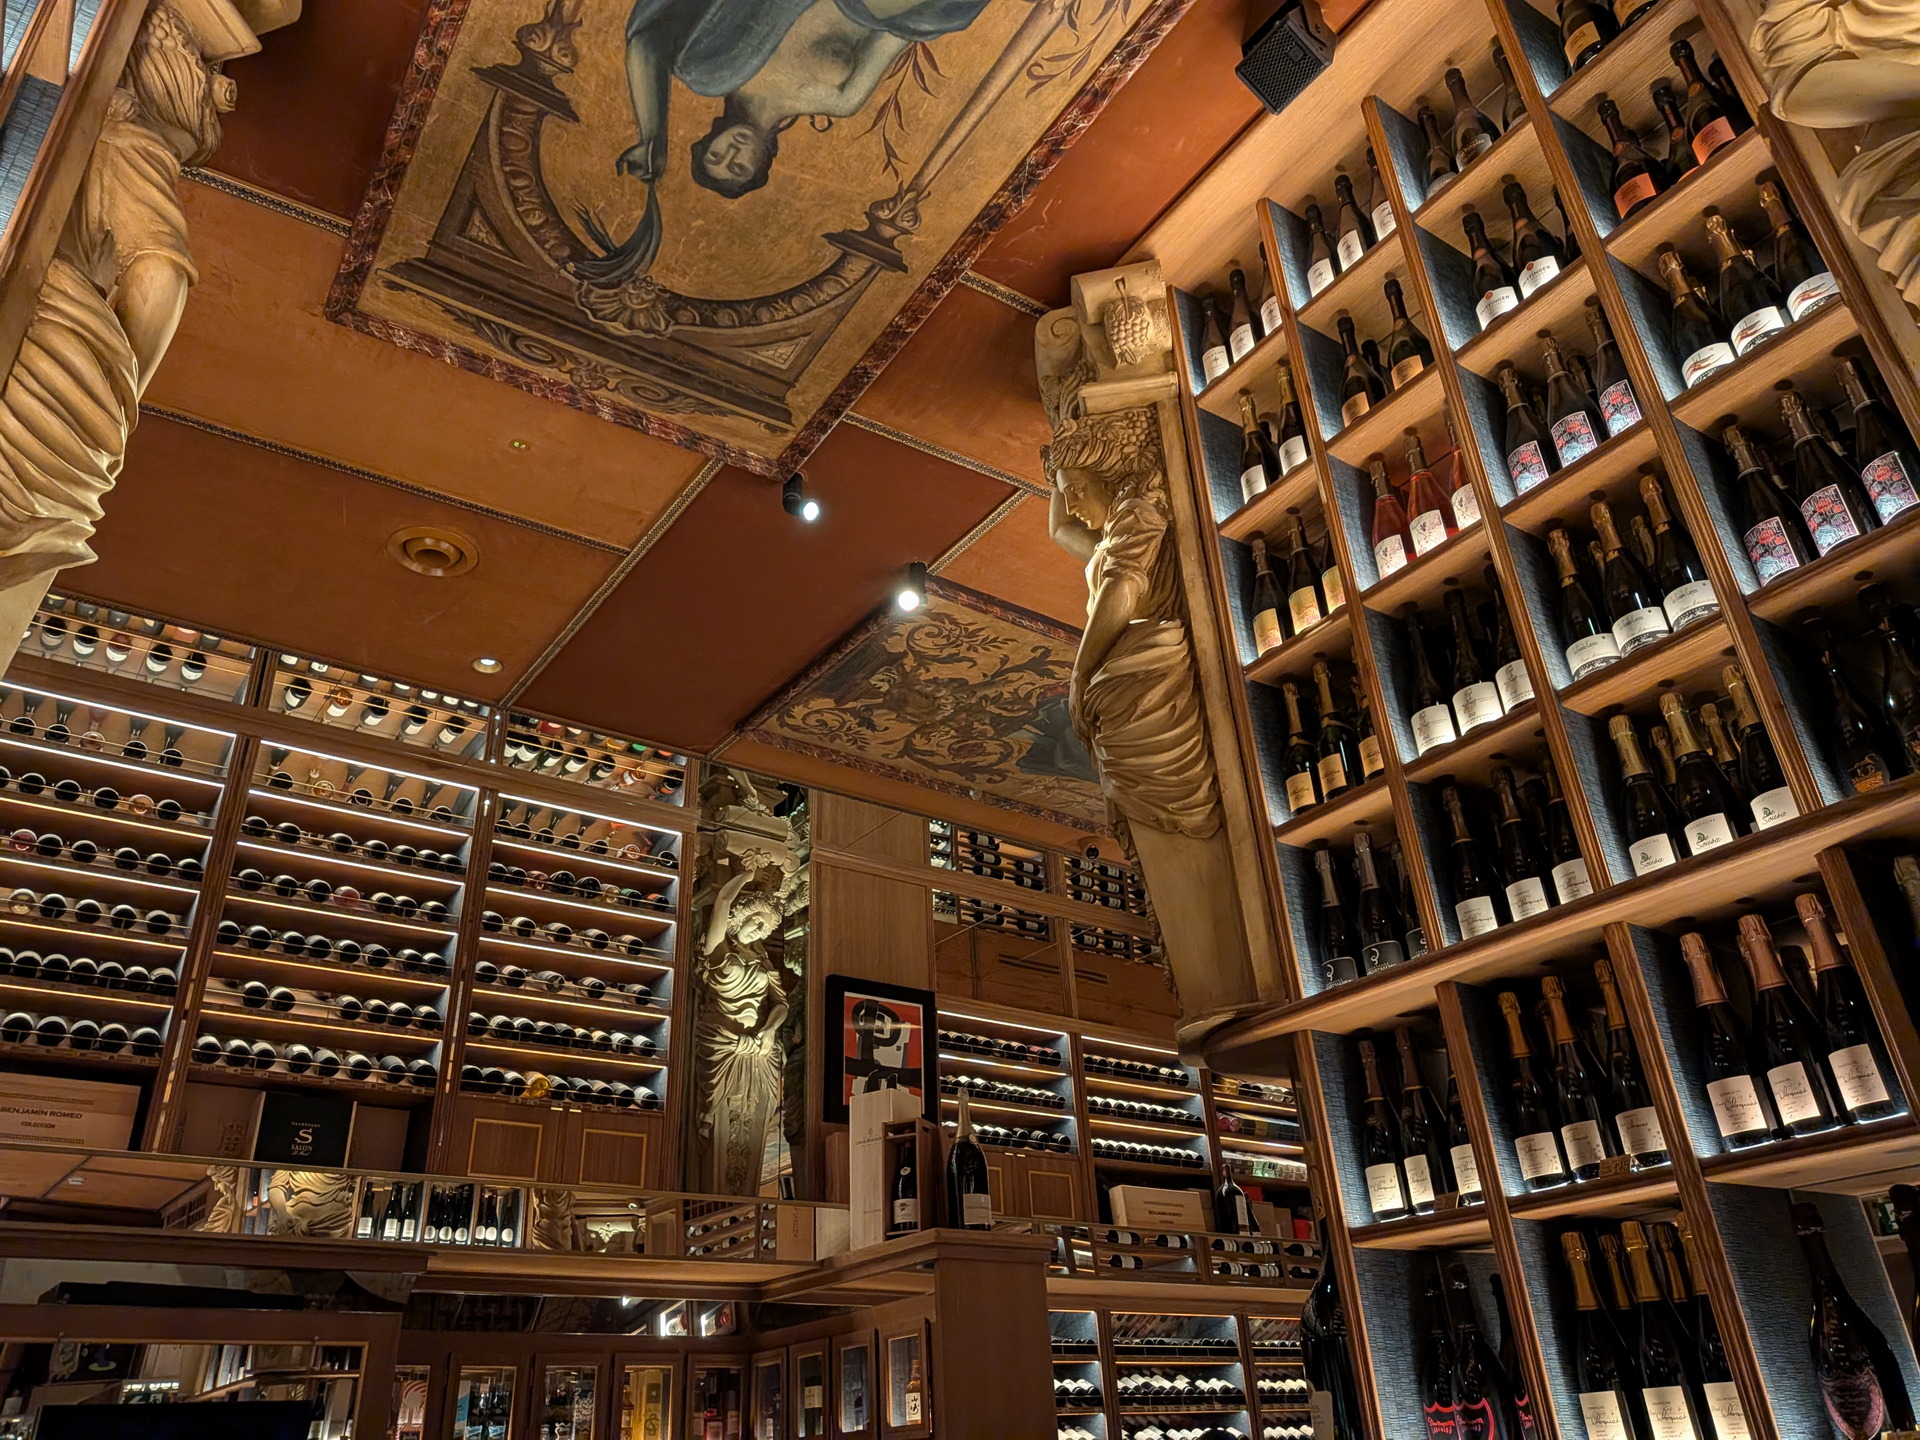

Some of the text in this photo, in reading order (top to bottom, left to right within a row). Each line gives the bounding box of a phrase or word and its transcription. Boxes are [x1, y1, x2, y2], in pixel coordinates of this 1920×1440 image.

[1762, 811, 1788, 824] Sousa
[1696, 836, 1722, 850] Sousa
[1640, 857, 1665, 870] Sousa
[0, 1106, 83, 1119] BENJAMIN ROMEO
[294, 1128, 312, 1144] S
